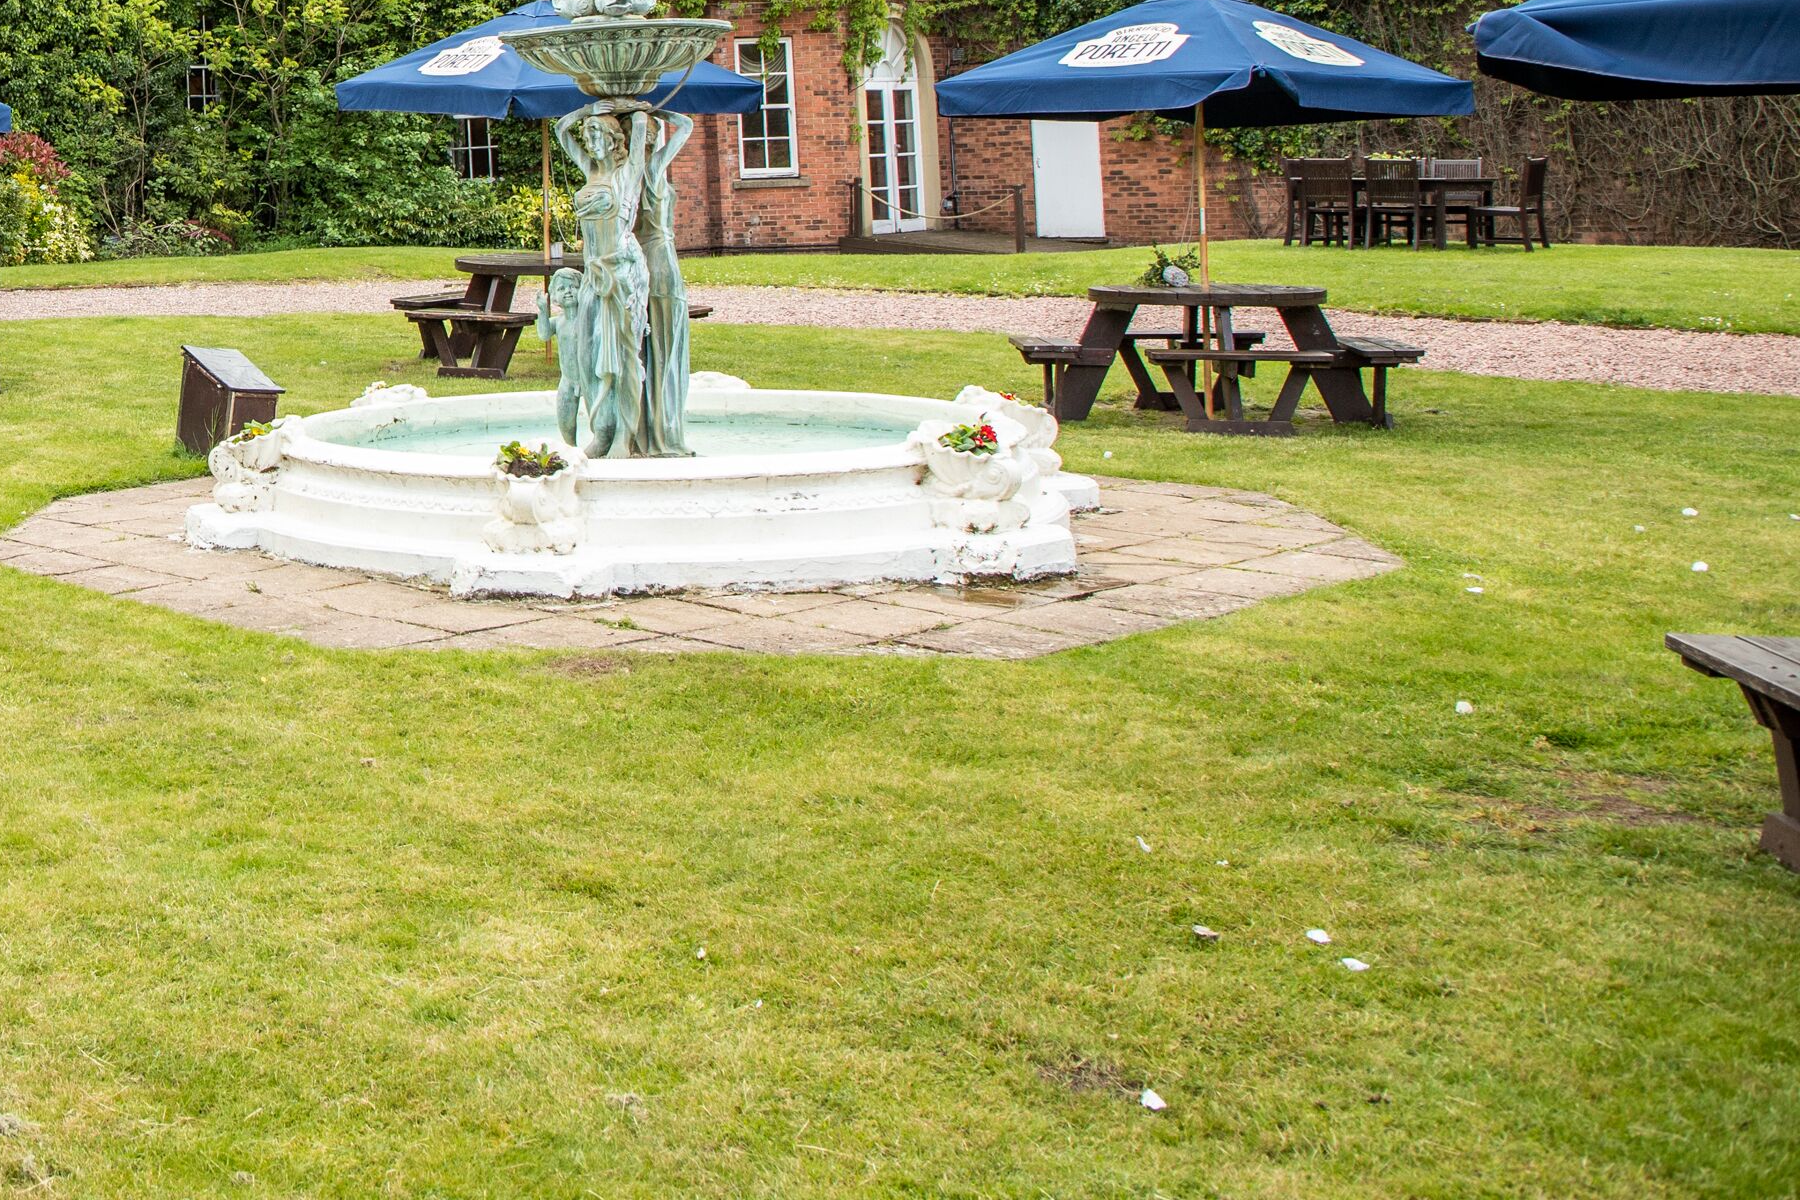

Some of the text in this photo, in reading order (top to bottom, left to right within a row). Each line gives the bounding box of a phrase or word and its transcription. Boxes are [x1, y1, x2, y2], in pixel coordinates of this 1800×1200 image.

[1111, 33, 1160, 44] ANGELO
[1073, 40, 1173, 60] PORETTI
[428, 54, 493, 69] PORETTI
